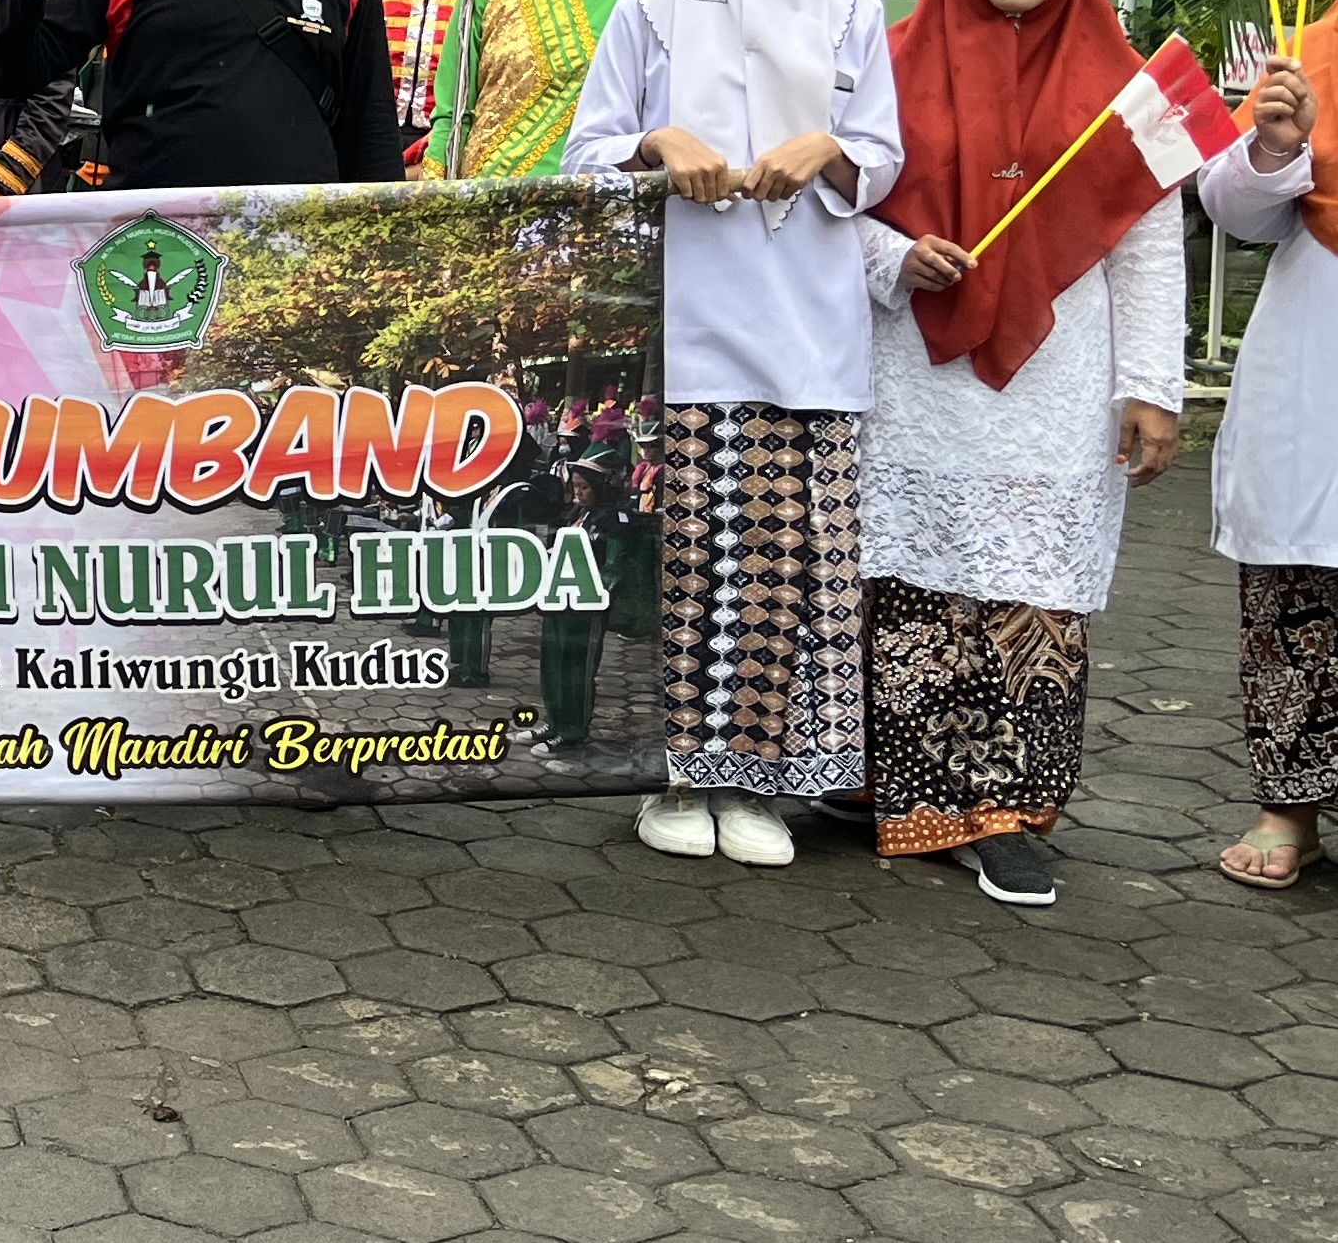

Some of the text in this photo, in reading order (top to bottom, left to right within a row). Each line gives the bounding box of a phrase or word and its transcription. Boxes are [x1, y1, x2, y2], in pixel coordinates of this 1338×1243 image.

[36, 539, 335, 618] NURUL
[351, 529, 607, 611] HUDA
[15, 646, 278, 699] Kaliwungu
[291, 641, 447, 687] Kudus
[63, 718, 251, 777] Mandiri
